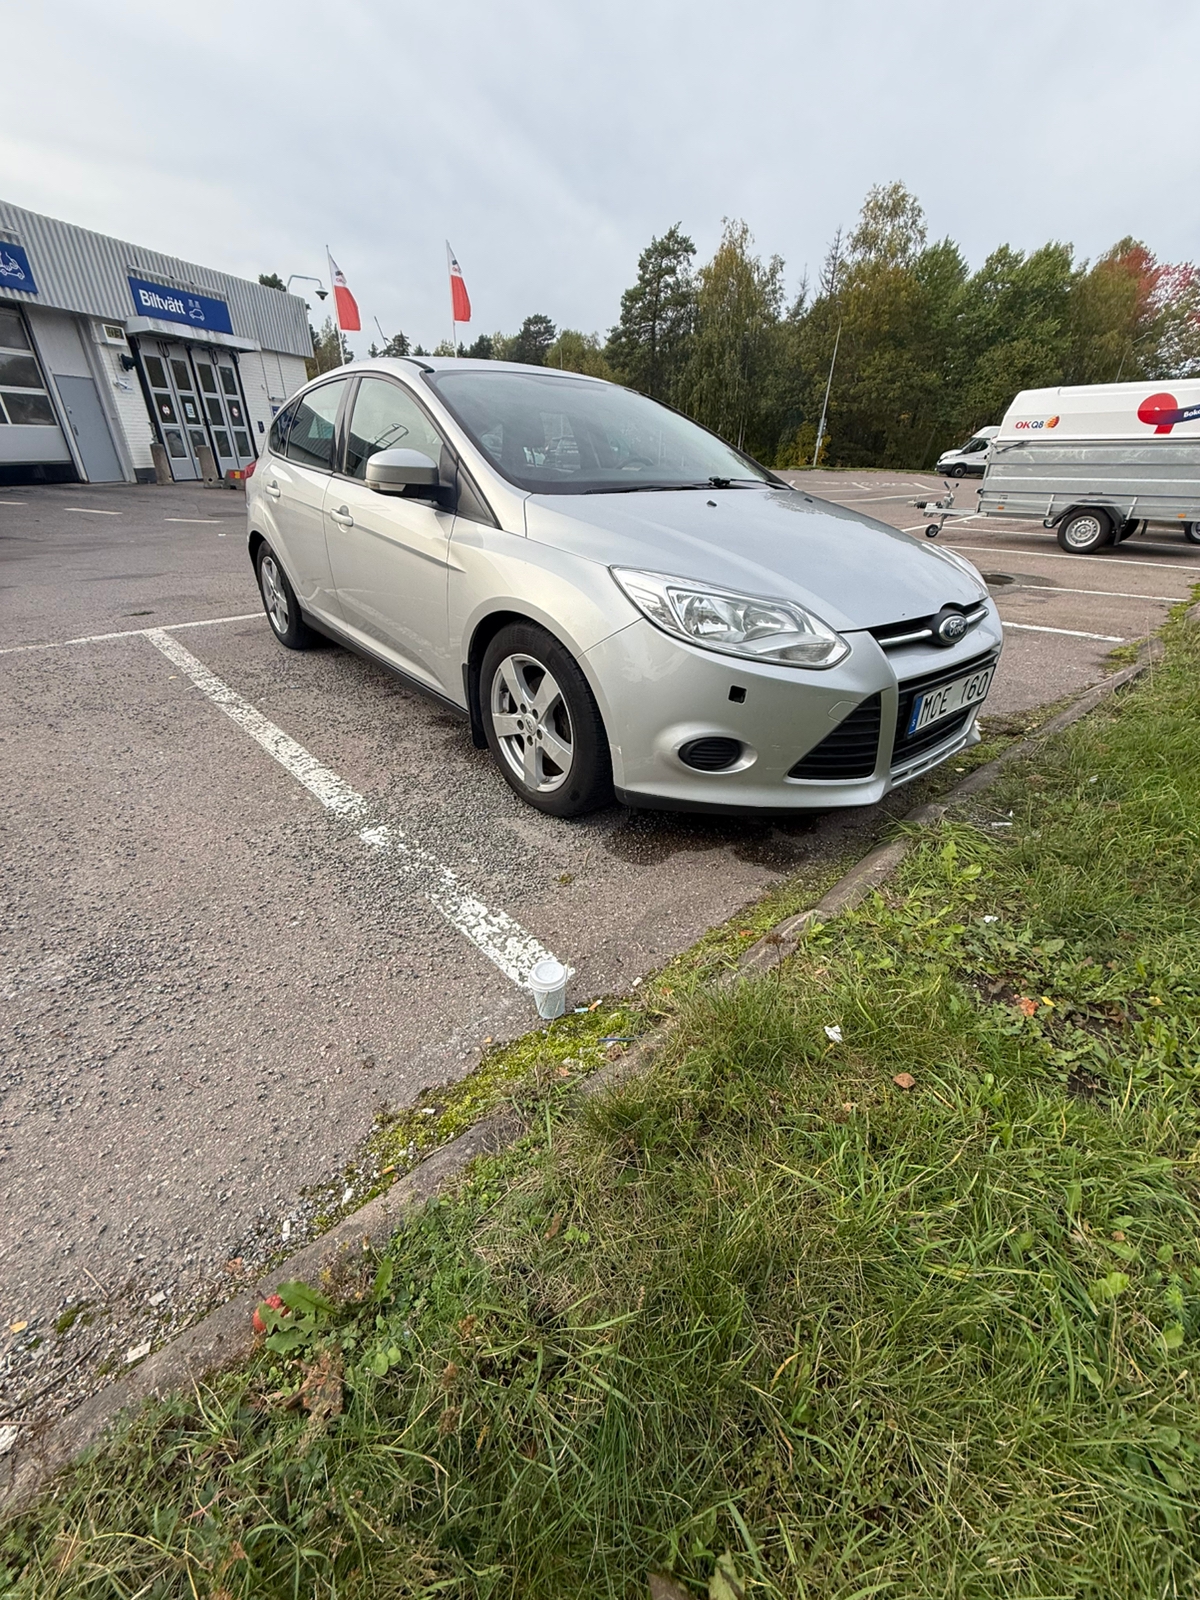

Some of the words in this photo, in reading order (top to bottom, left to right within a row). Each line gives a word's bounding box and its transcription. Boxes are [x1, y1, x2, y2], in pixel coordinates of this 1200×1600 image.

[139, 289, 186, 315] Biltvätt
[1015, 420, 1044, 429] OKQ8
[949, 619, 965, 636] Ford
[919, 686, 952, 726] MCE
[960, 671, 989, 704] 160
